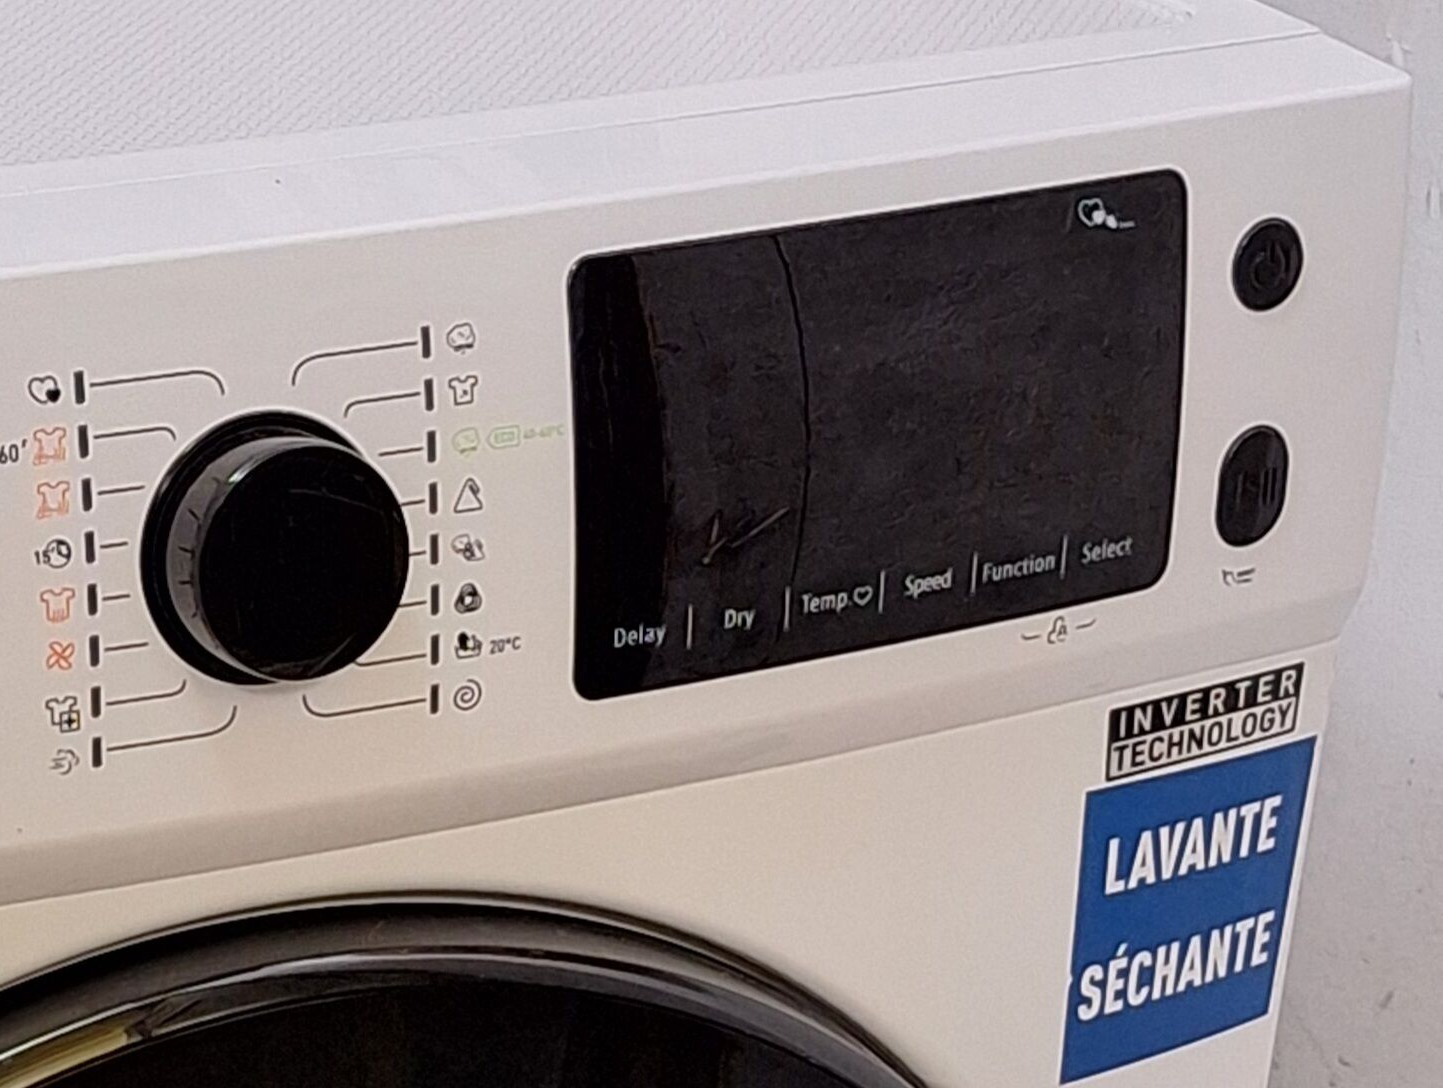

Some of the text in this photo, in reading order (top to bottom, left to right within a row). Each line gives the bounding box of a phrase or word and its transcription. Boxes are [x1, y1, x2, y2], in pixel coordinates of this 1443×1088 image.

[613, 623, 667, 649] Delay
[723, 608, 756, 631] Dry
[904, 567, 954, 599] Speed
[981, 553, 1056, 584] Function
[1080, 536, 1134, 565] Select
[1112, 701, 1294, 772] TECHNOLOGY
[1118, 668, 1299, 739] INVERTER
[1104, 794, 1283, 897] LAVANTE
[1076, 910, 1277, 1022] SÉCHANTE
